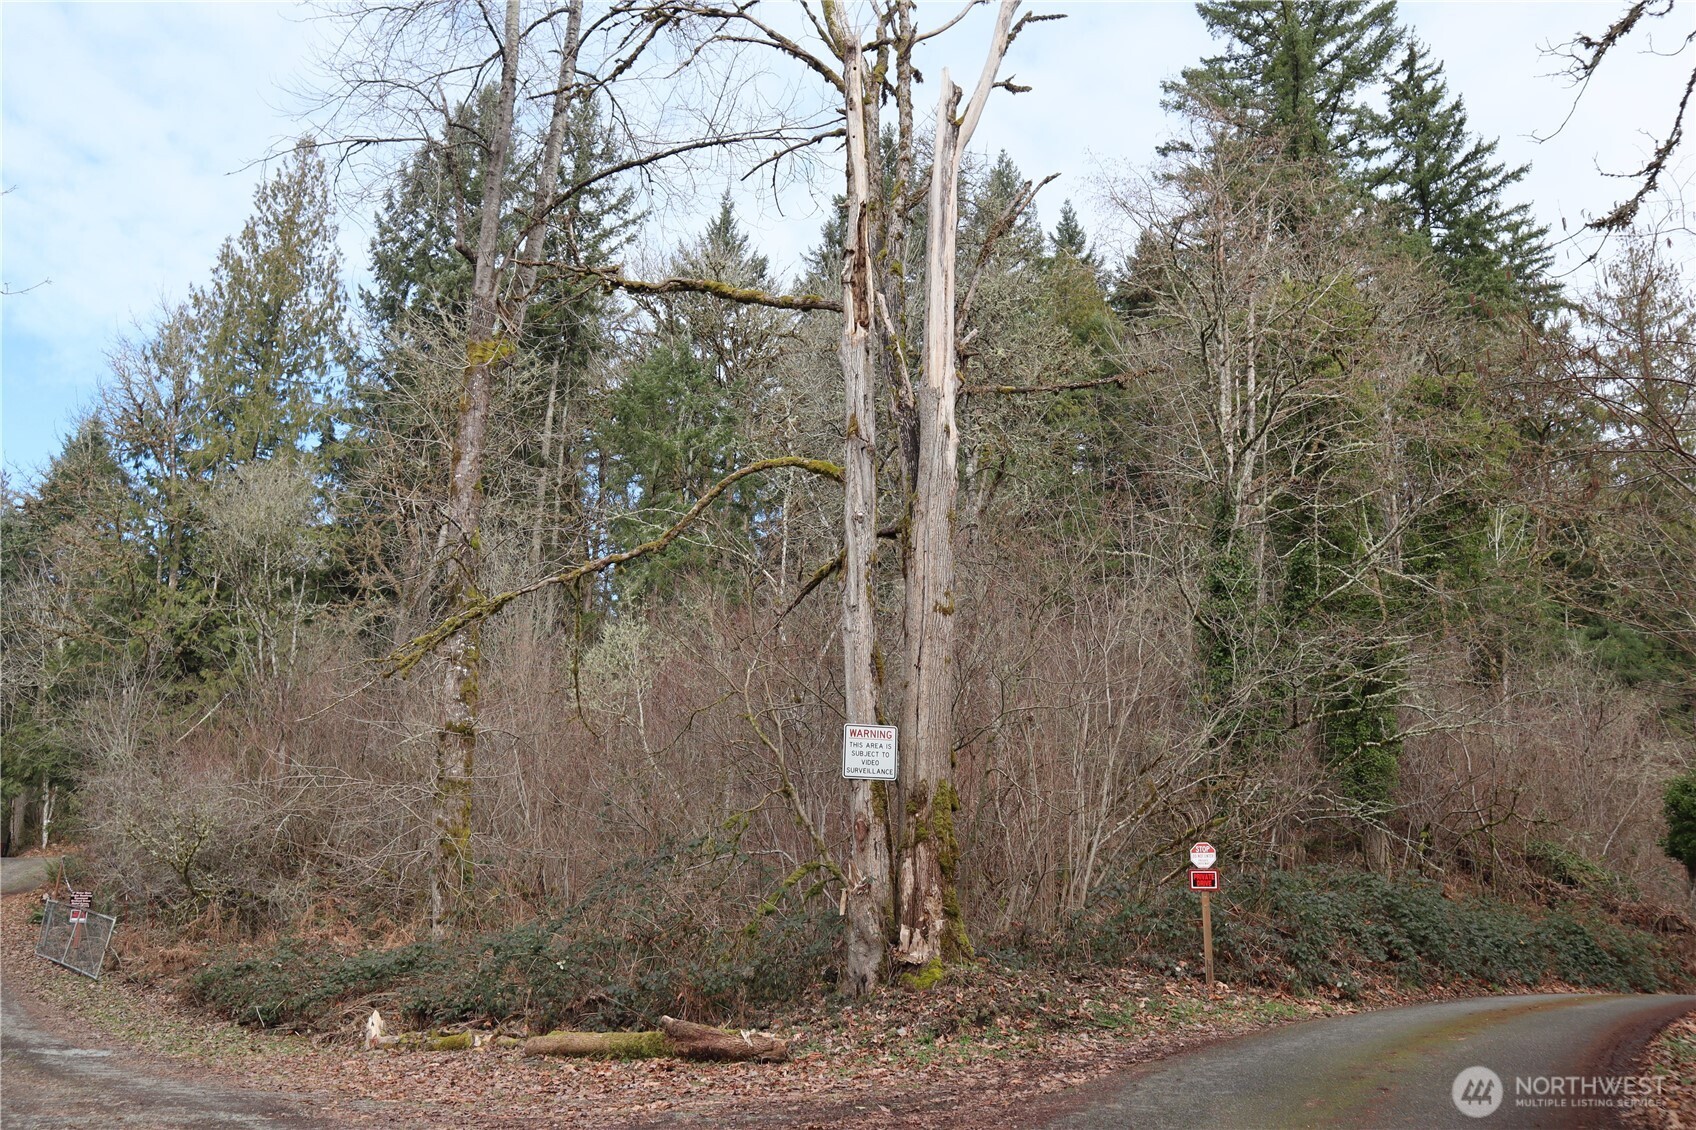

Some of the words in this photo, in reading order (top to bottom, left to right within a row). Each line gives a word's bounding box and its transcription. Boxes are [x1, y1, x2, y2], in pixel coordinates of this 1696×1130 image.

[849, 729, 893, 739] WARNING
[846, 767, 893, 775] SURVEILLANCE
[1195, 845, 1210, 853] STOP
